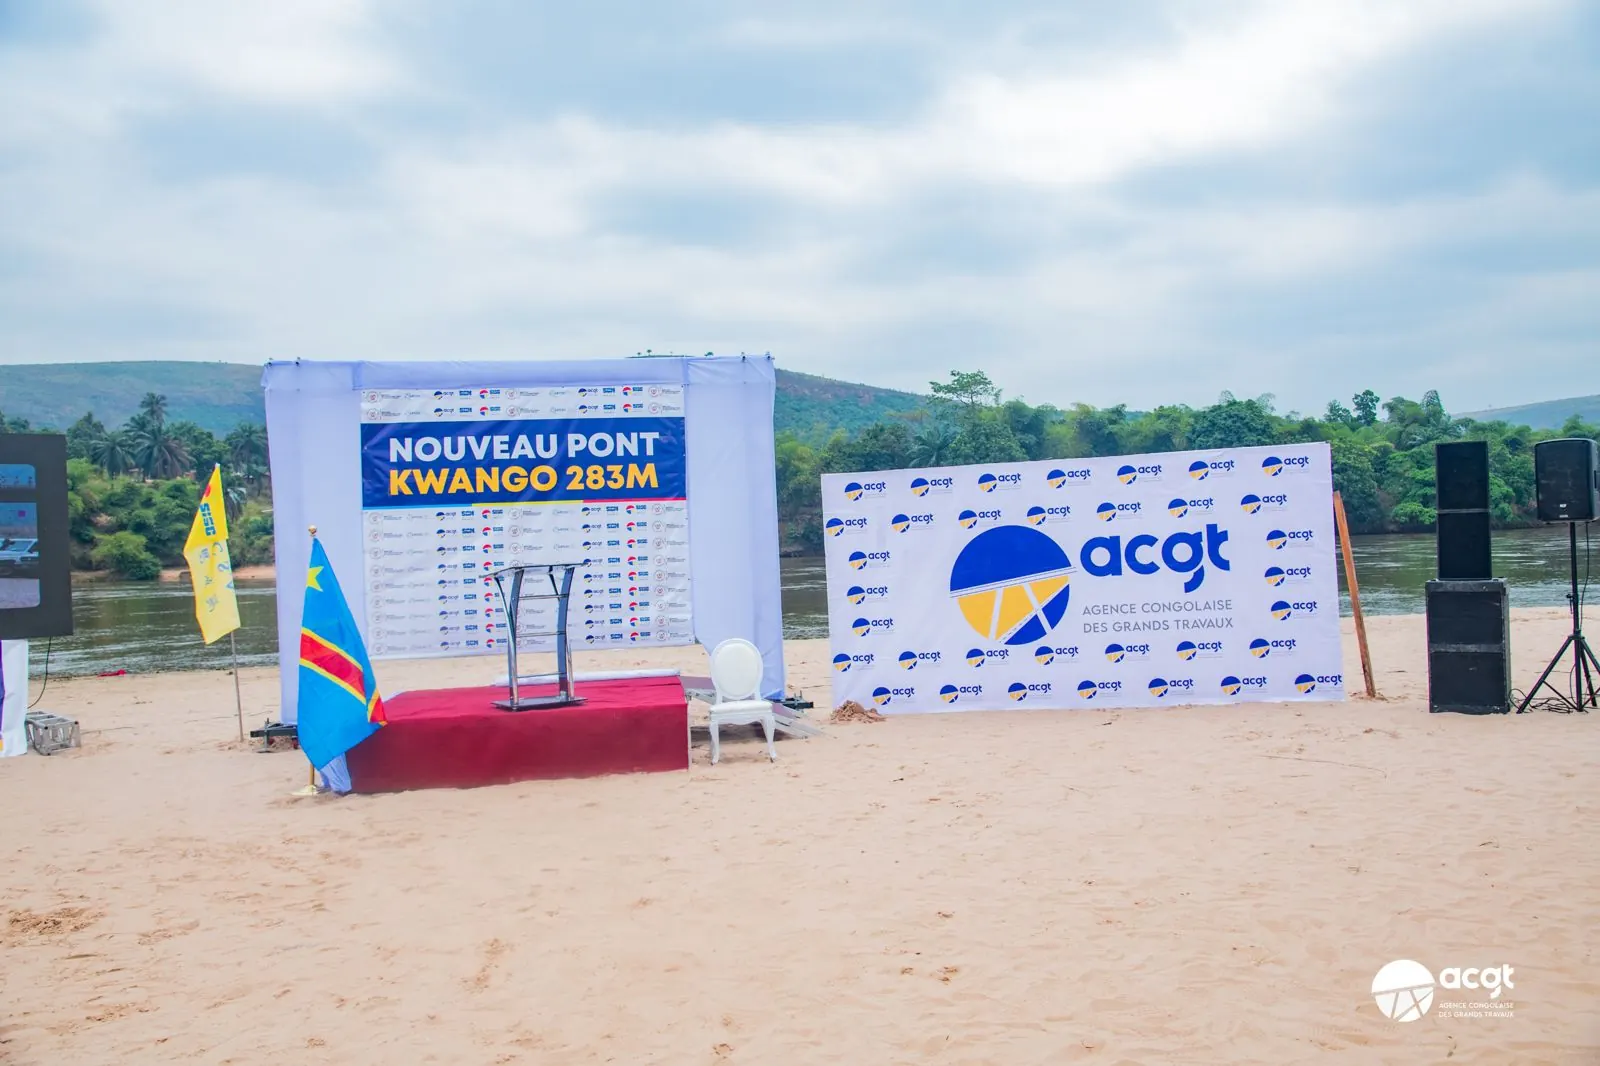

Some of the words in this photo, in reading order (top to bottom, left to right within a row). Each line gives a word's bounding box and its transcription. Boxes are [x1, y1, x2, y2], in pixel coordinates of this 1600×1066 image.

[389, 434, 558, 462] NOUVEAU
[567, 432, 660, 458] PONT
[1210, 460, 1234, 471] acgt
[1284, 456, 1309, 467] acgt
[1067, 469, 1091, 480] acgt
[1138, 465, 1162, 476] acgt
[389, 465, 558, 496] KWANGO
[567, 464, 659, 490] 283M
[930, 477, 953, 488] acgt
[998, 473, 1021, 484] acgt
[864, 482, 886, 492] acgt
[1189, 498, 1213, 509] acgt
[1262, 494, 1287, 505] acgt
[1047, 506, 1070, 517] acgt
[1117, 502, 1141, 513] acgt
[911, 514, 933, 524] acgt
[978, 510, 1001, 520] acgt
[845, 518, 867, 528] acgt
[1288, 530, 1313, 541] acgt
[868, 551, 890, 562] acgt
[1080, 524, 1230, 593] acgt
[1286, 567, 1311, 578] acgt
[866, 586, 888, 596] acgt
[1083, 603, 1137, 616] AGENCE
[1142, 599, 1233, 613] CONGOLAISE
[1292, 601, 1317, 612] acgt
[871, 618, 893, 629] acgt
[1083, 622, 1108, 634] DES
[1112, 620, 1170, 632] GRANDS
[1174, 618, 1234, 630] TRAVAUX
[1126, 644, 1149, 655] acgt
[1198, 641, 1222, 652] acgt
[1271, 639, 1296, 650] acgt
[918, 651, 941, 662] acgt
[986, 649, 1009, 659] acgt
[1055, 646, 1078, 657] acgt
[852, 654, 874, 664] acgt
[1169, 679, 1193, 689] acgt
[1242, 676, 1267, 687] acgt
[1317, 674, 1342, 686] acgt
[960, 685, 982, 695] acgt
[1028, 683, 1051, 693] acgt
[1098, 681, 1121, 691] acgt
[892, 687, 914, 698] acgt
